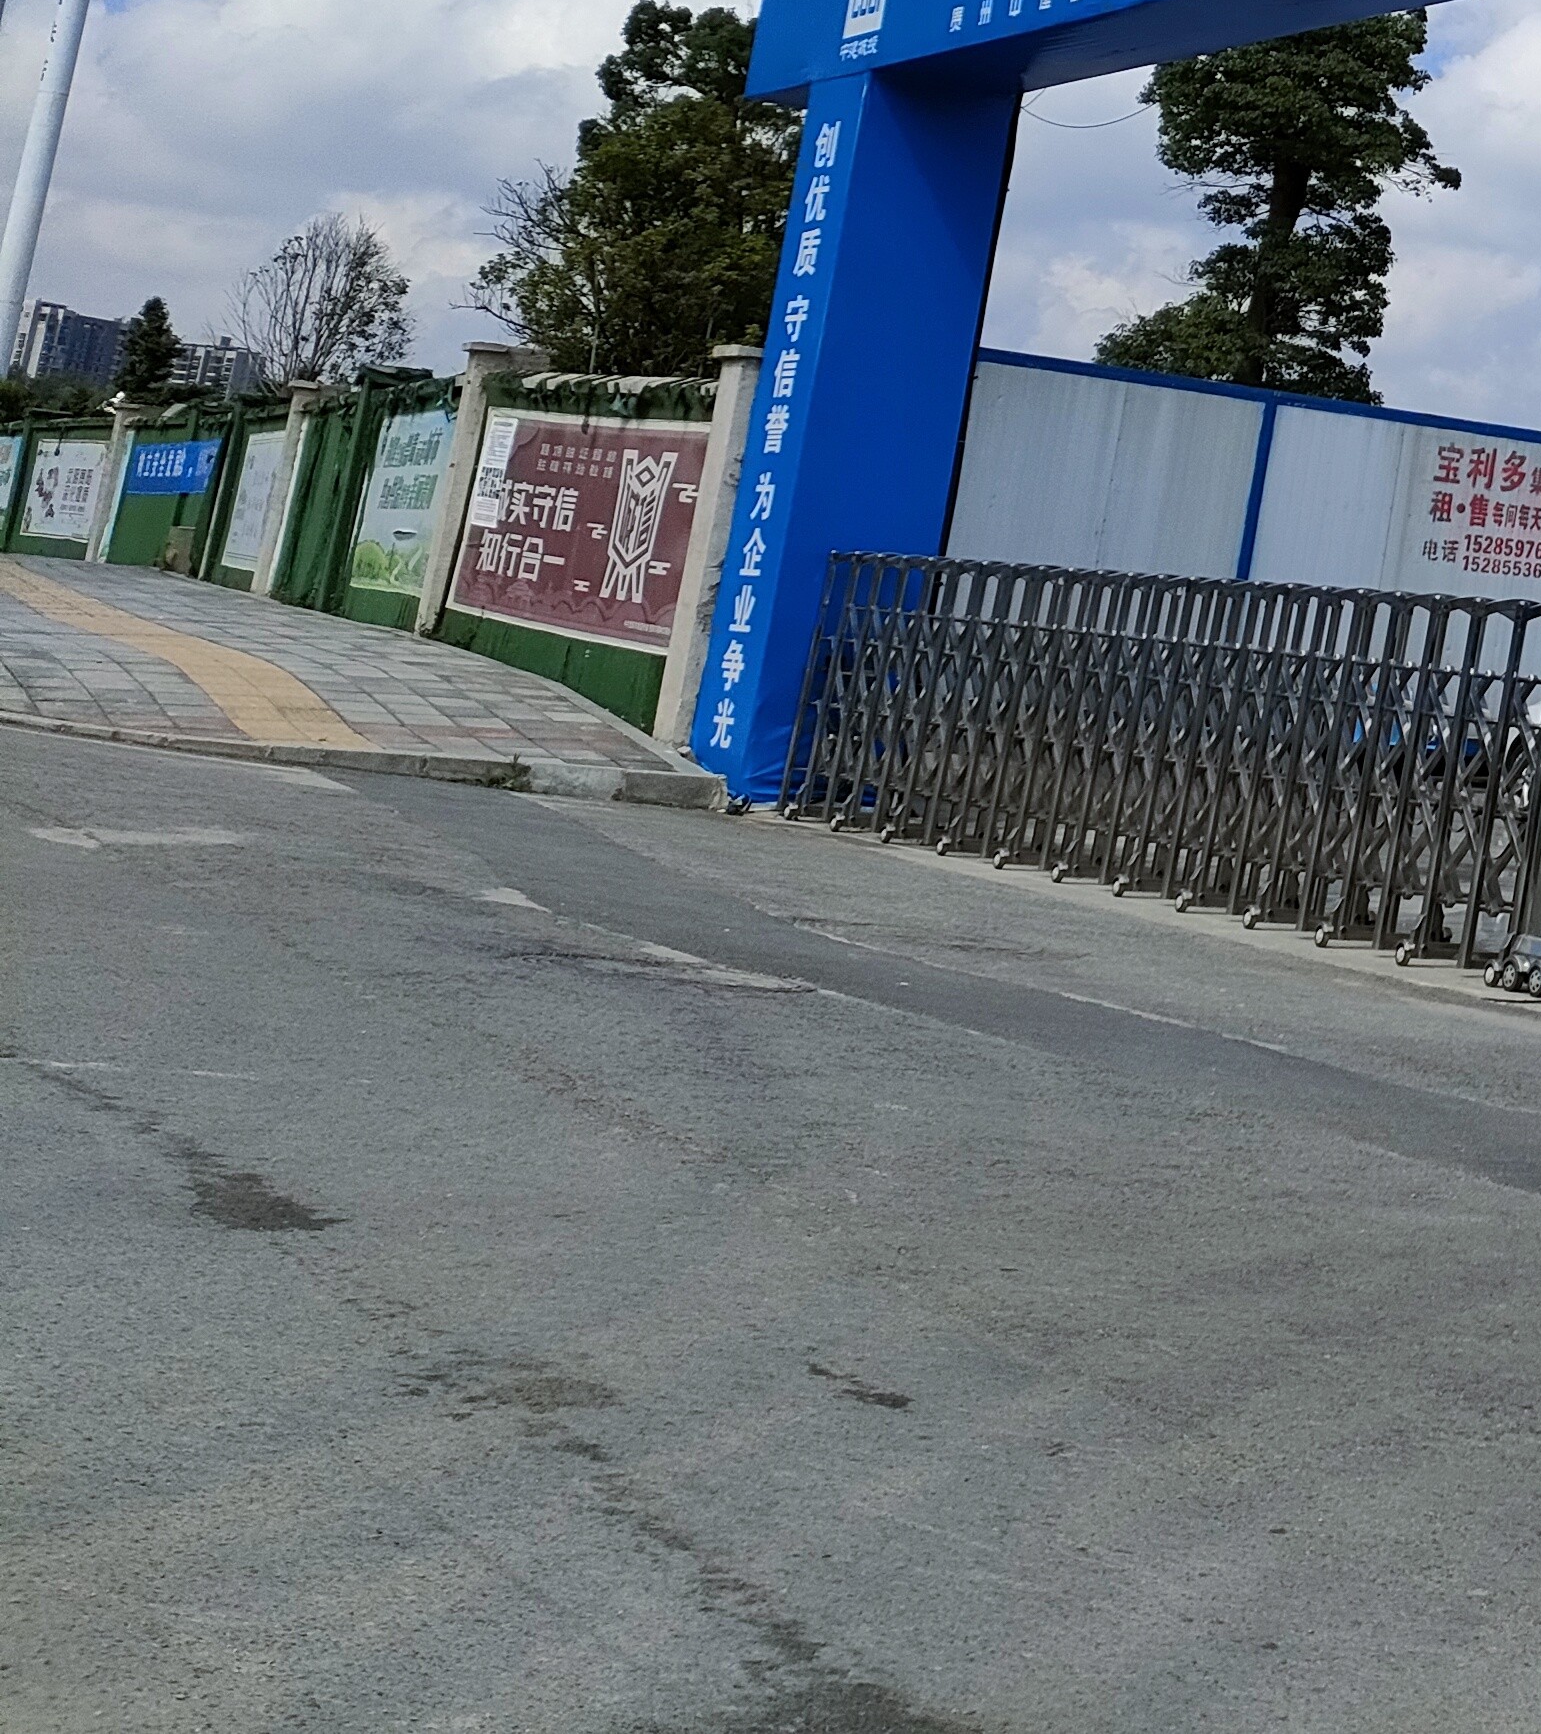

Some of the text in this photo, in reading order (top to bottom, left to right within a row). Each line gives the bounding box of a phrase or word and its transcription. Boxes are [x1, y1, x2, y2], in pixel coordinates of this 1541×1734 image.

[709, 120, 841, 750] 创优质 守信誉 为企业争光
[476, 529, 565, 581] 知行合一
[1422, 539, 1459, 563] 电话
